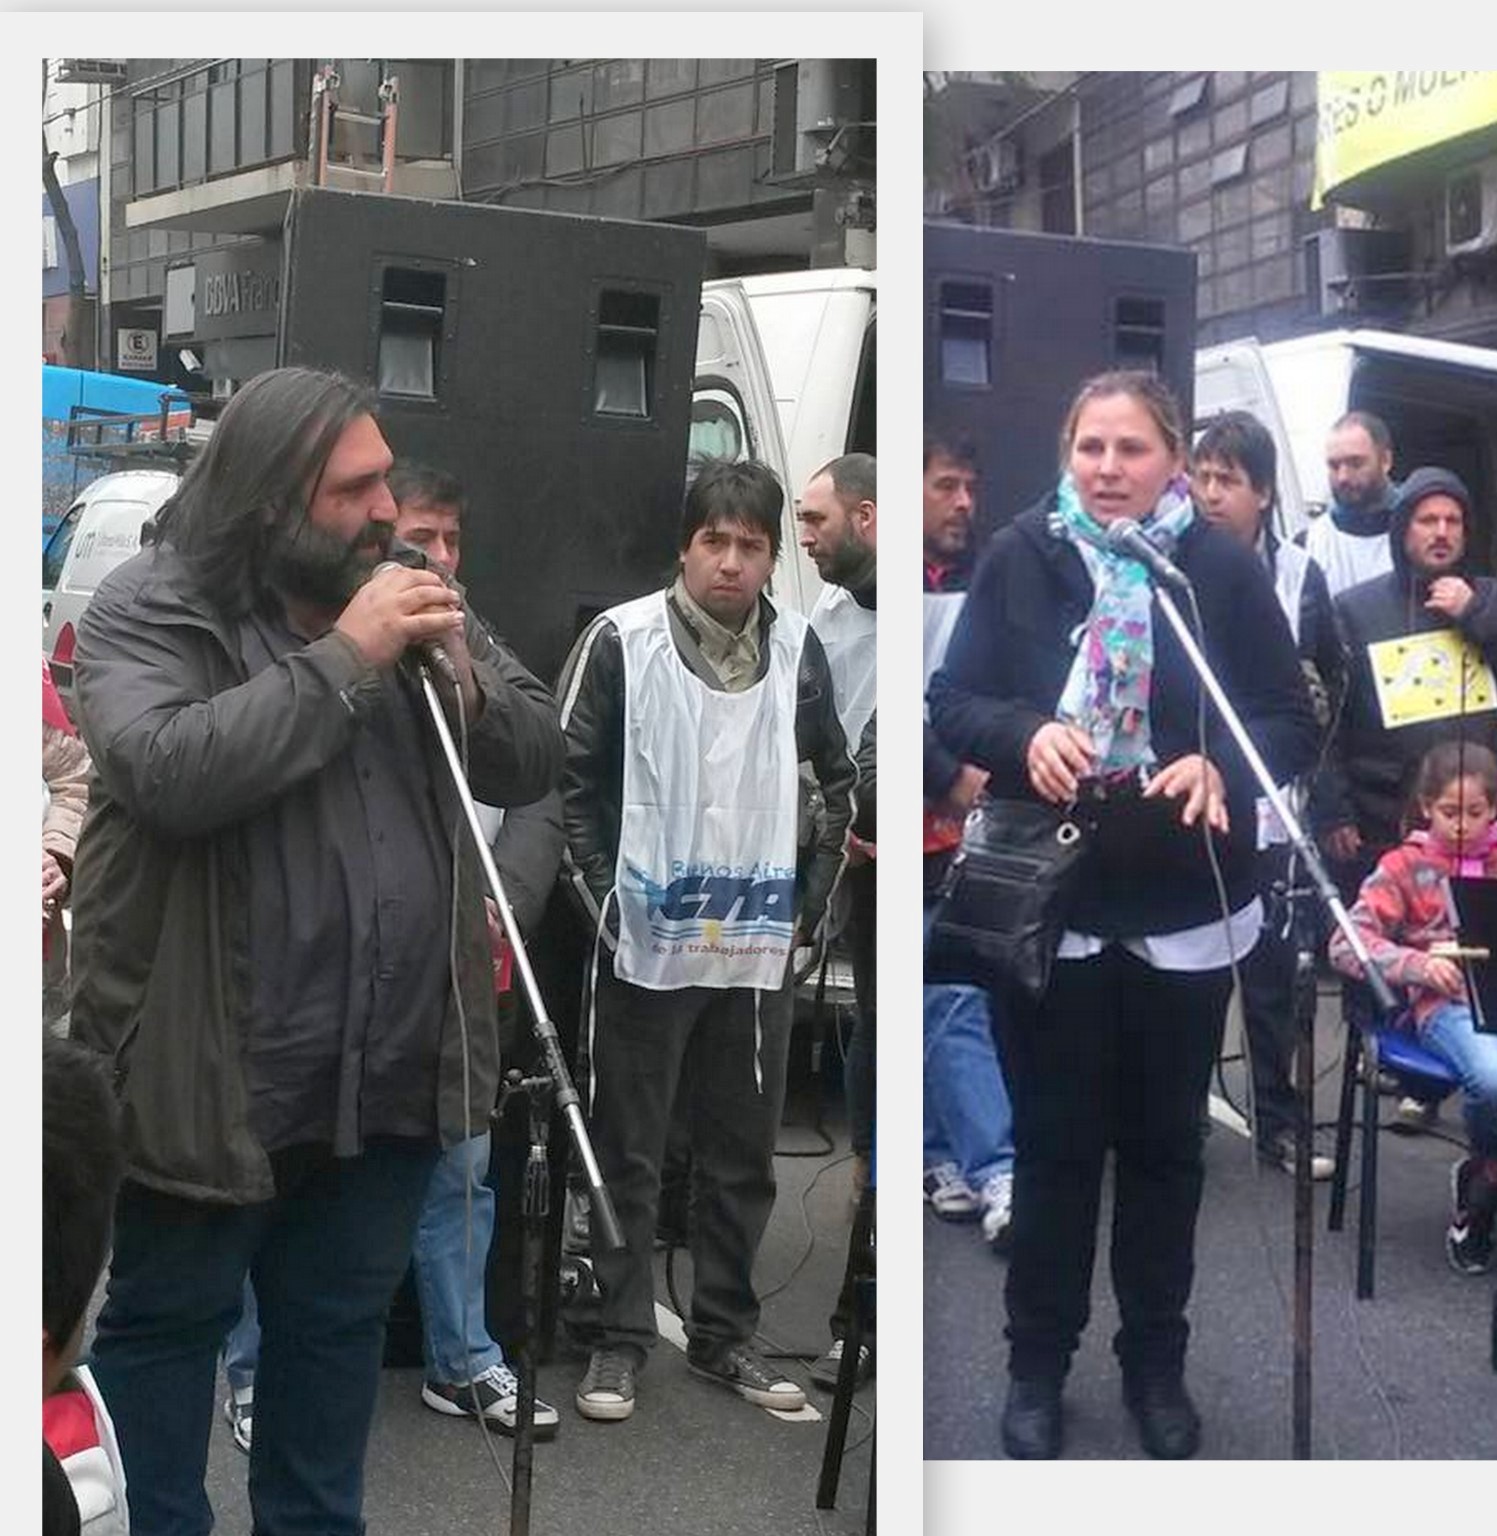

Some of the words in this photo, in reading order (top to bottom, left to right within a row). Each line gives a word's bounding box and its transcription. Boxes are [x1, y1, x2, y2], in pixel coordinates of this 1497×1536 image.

[205, 273, 240, 314] BBVA
[752, 861, 796, 879] Aire
[661, 876, 796, 922] CTA
